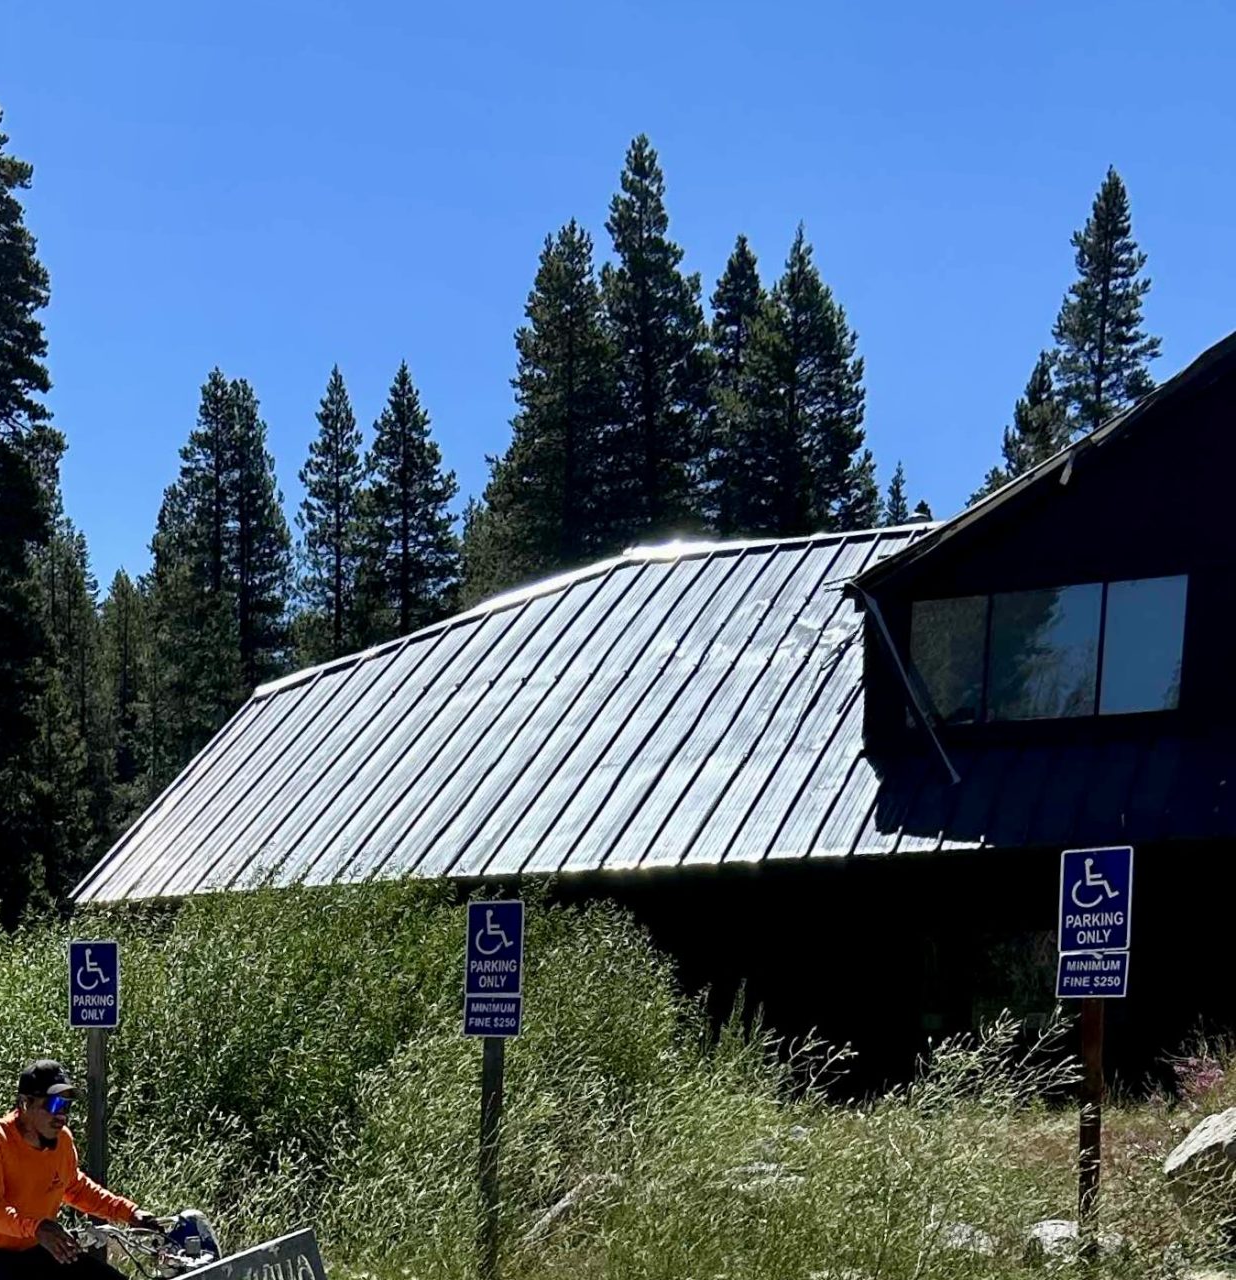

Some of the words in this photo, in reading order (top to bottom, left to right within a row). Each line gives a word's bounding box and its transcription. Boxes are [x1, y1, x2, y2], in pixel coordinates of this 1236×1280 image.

[1065, 911, 1124, 929] PARKING
[1076, 929, 1112, 945] ONLY
[470, 959, 517, 974] PARKING
[1066, 960, 1121, 972] MINIMUM
[478, 975, 507, 988] ONLY
[1063, 976, 1090, 987] FINE
[1093, 976, 1121, 987] $250
[73, 994, 114, 1007] PARKING
[471, 1002, 516, 1013] MINIMUM
[80, 1008, 106, 1021] ONLY
[468, 1017, 491, 1028] FINE
[493, 1017, 517, 1028] $250
